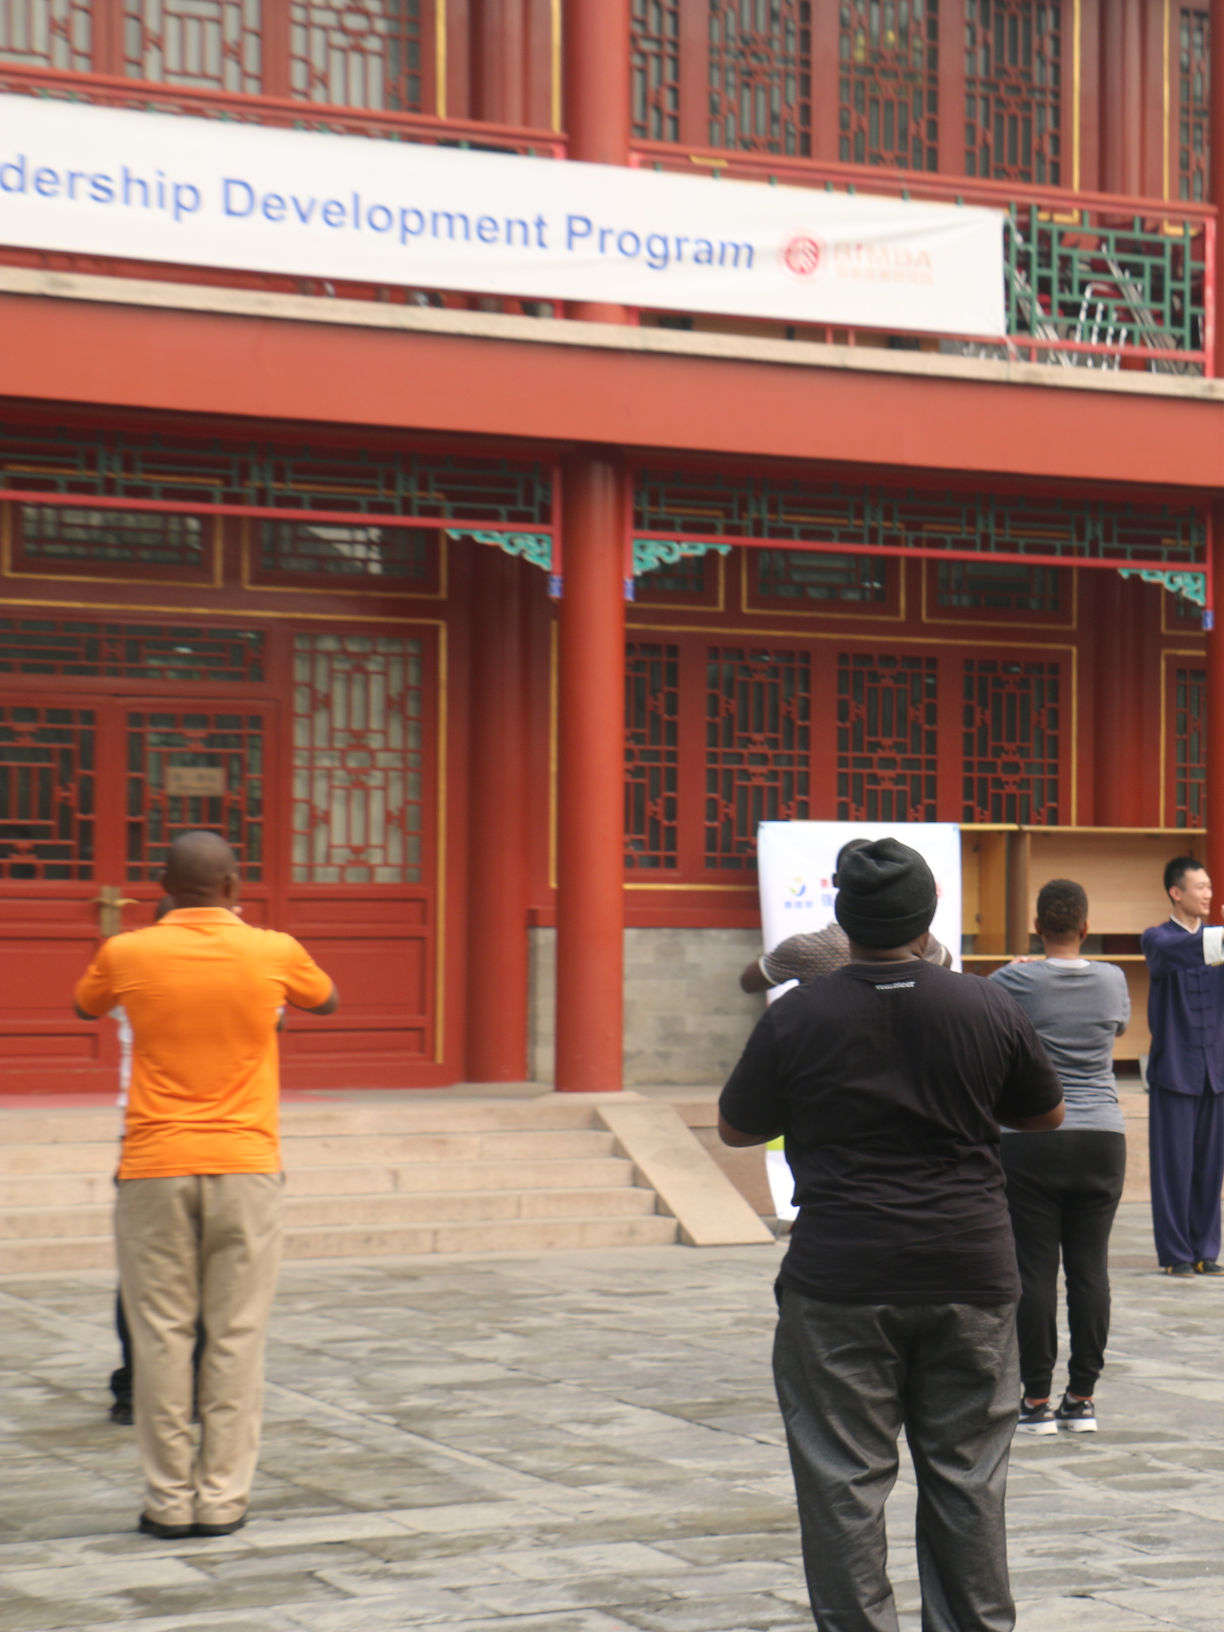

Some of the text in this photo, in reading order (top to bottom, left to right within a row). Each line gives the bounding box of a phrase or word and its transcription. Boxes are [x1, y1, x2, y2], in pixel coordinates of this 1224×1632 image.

[0, 154, 755, 271] dership Development Program
